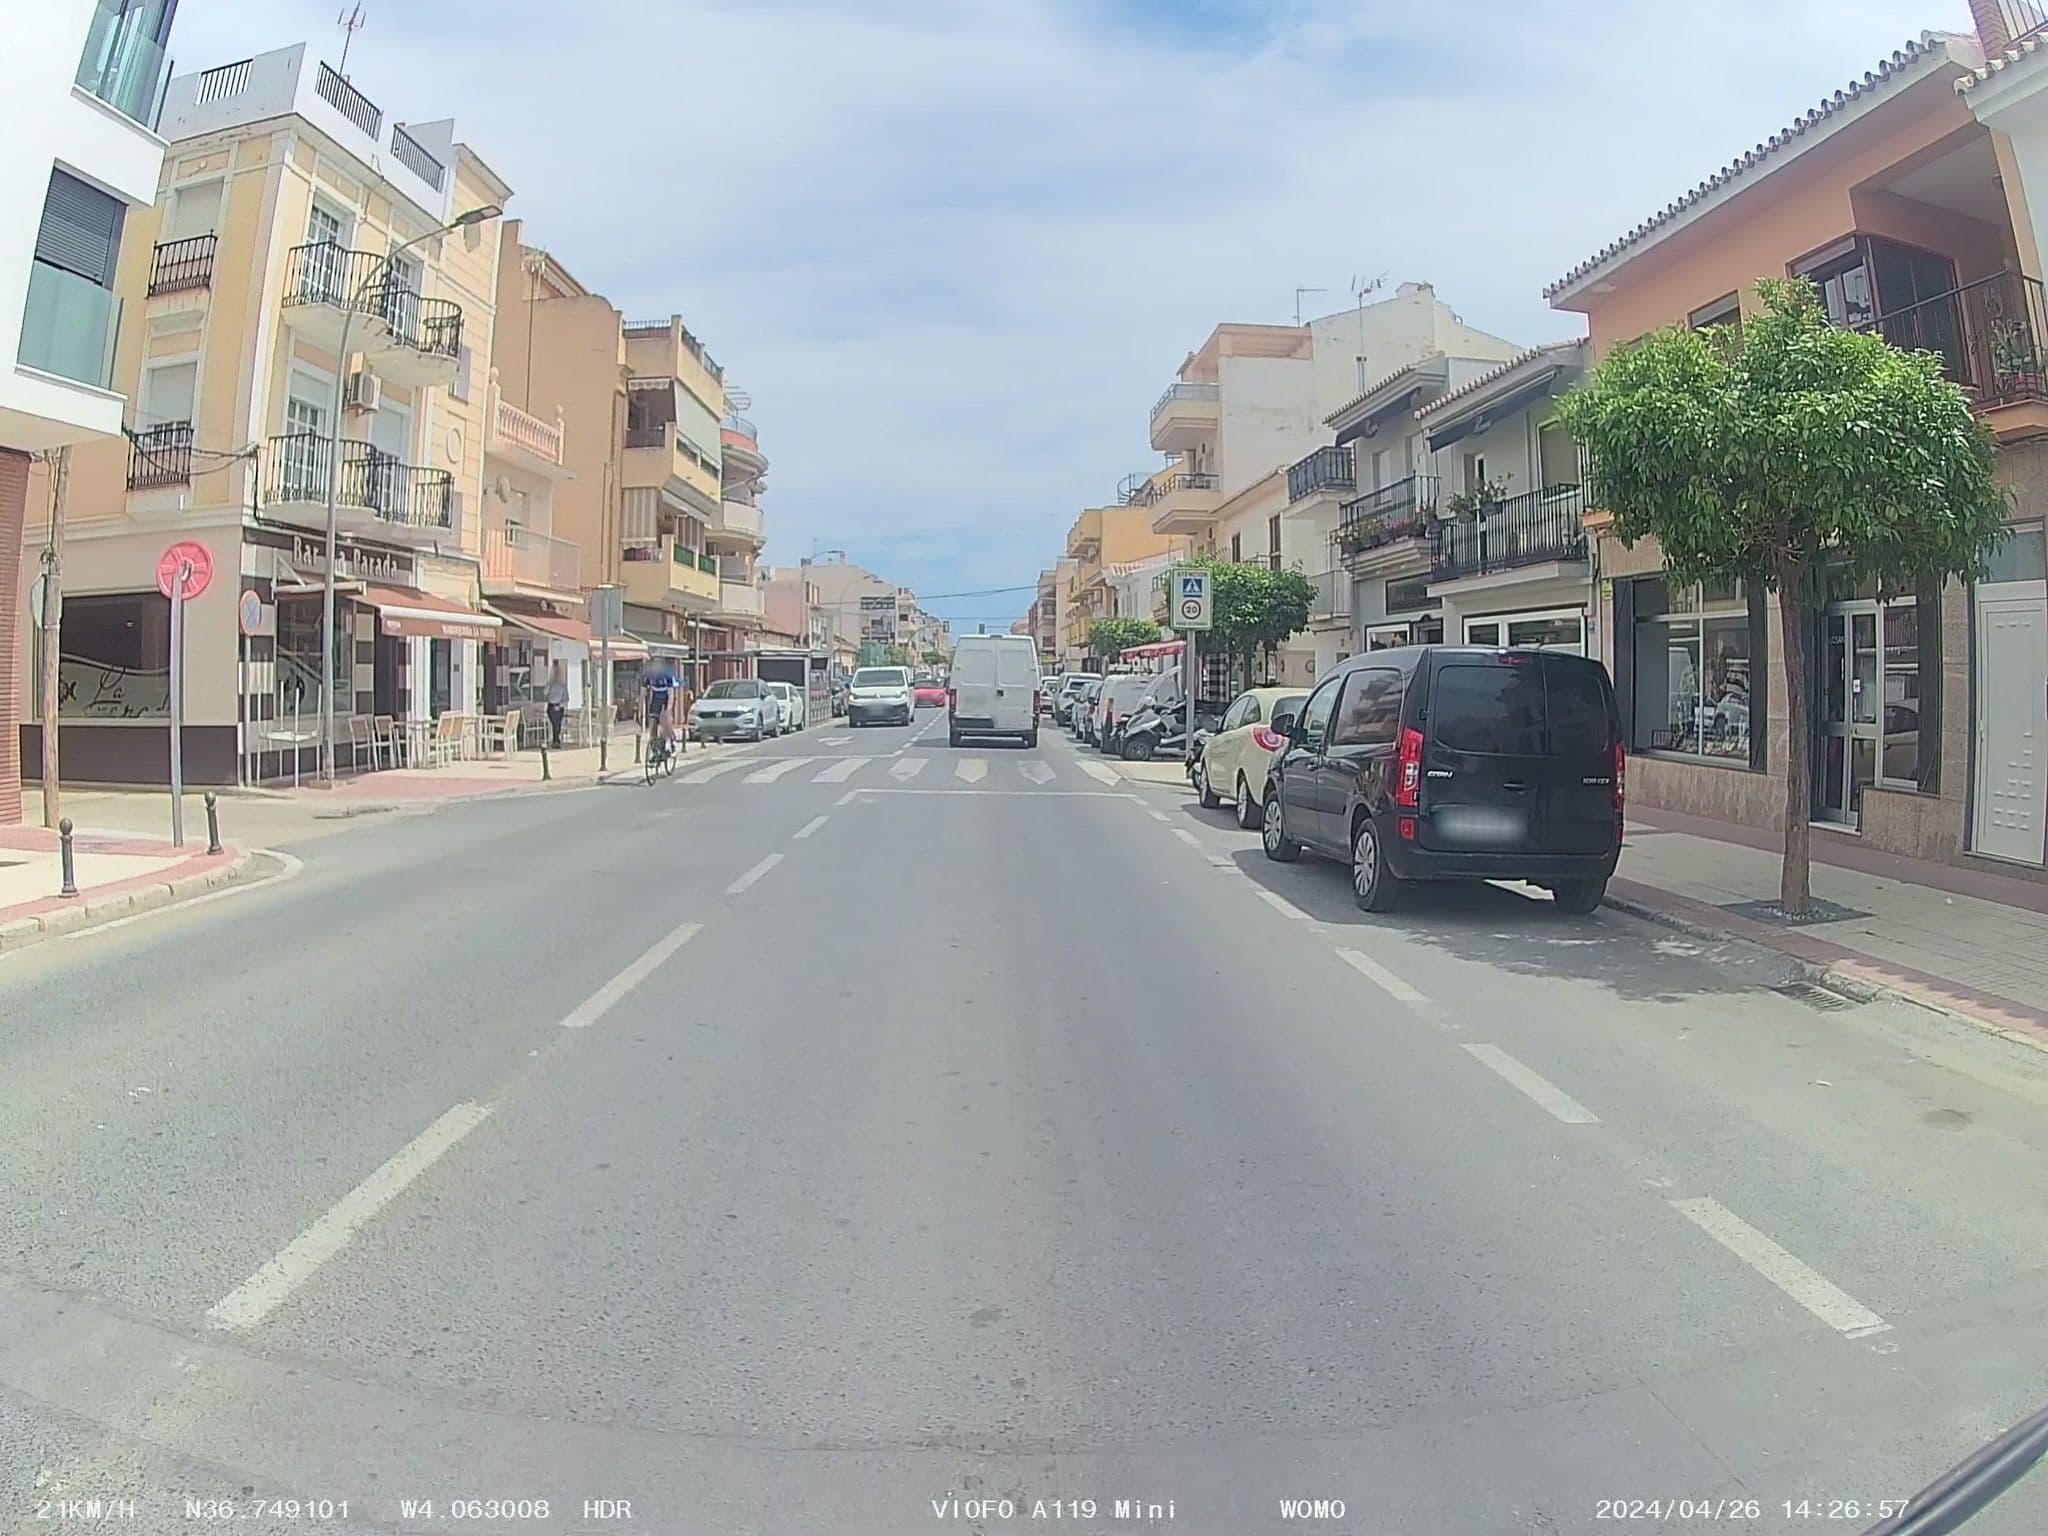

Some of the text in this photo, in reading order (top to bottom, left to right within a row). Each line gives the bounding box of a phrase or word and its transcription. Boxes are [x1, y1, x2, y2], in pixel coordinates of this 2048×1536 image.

[293, 535, 319, 566] Bar
[353, 548, 398, 579] Parada
[1185, 605, 1198, 614] 20
